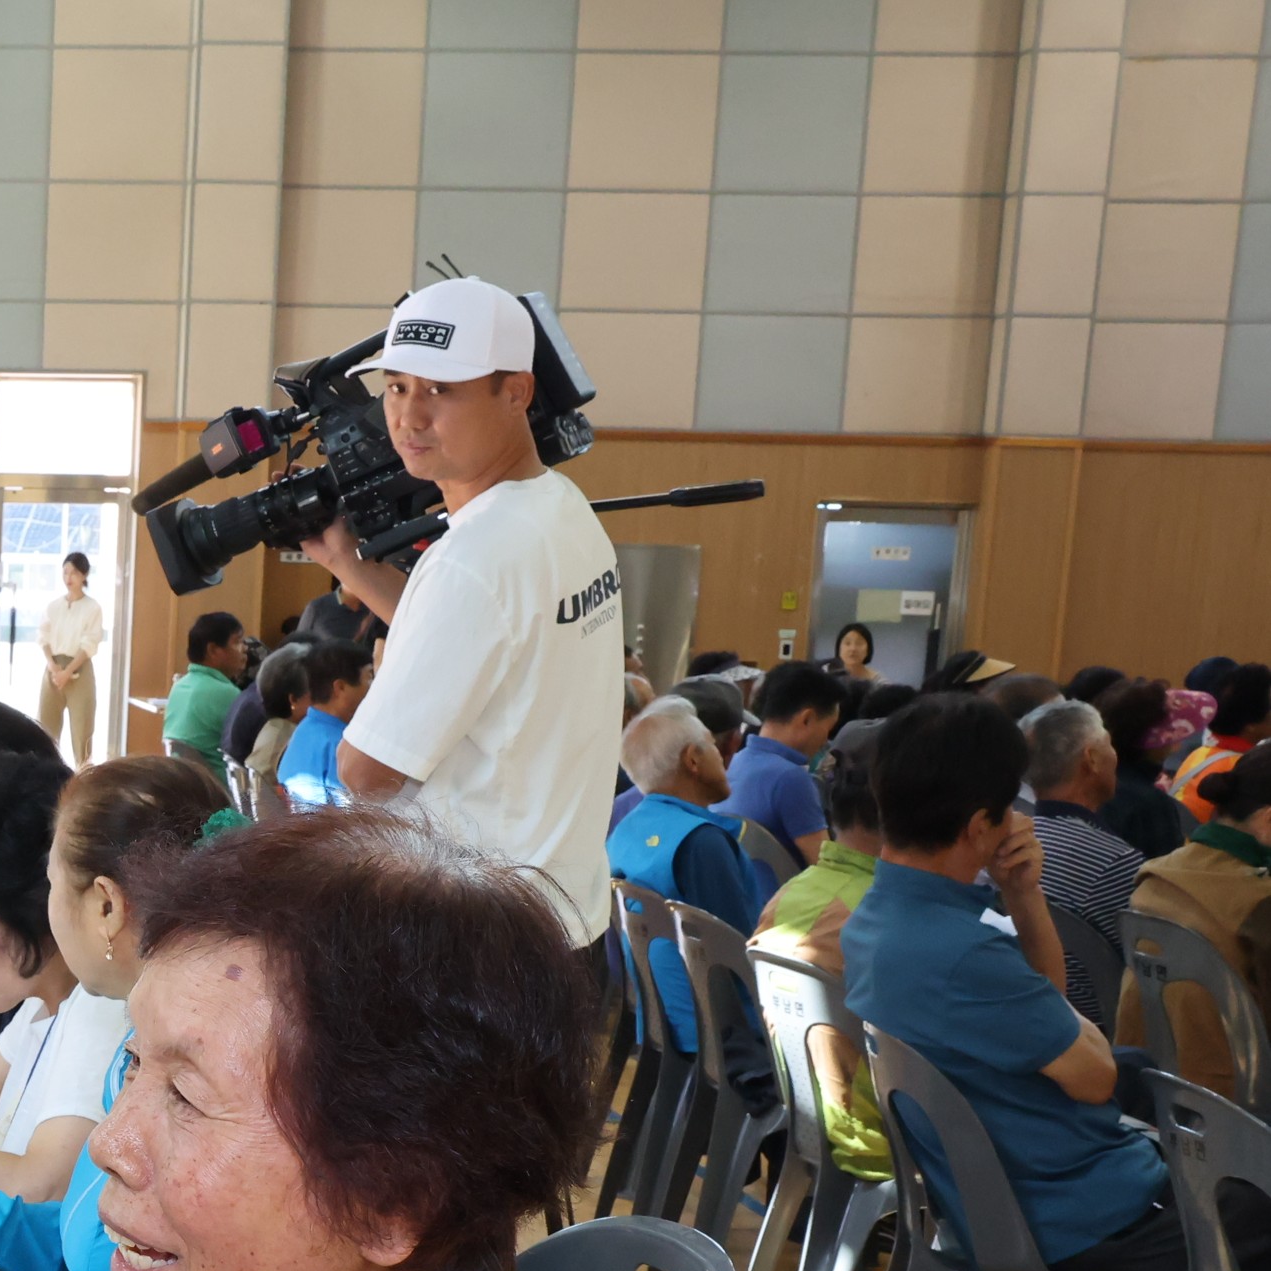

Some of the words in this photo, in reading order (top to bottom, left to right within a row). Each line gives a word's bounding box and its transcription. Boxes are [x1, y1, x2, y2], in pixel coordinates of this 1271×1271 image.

[399, 325, 447, 336] TAYLOR
[397, 332, 445, 343] MADE
[556, 563, 621, 625] UMBR
